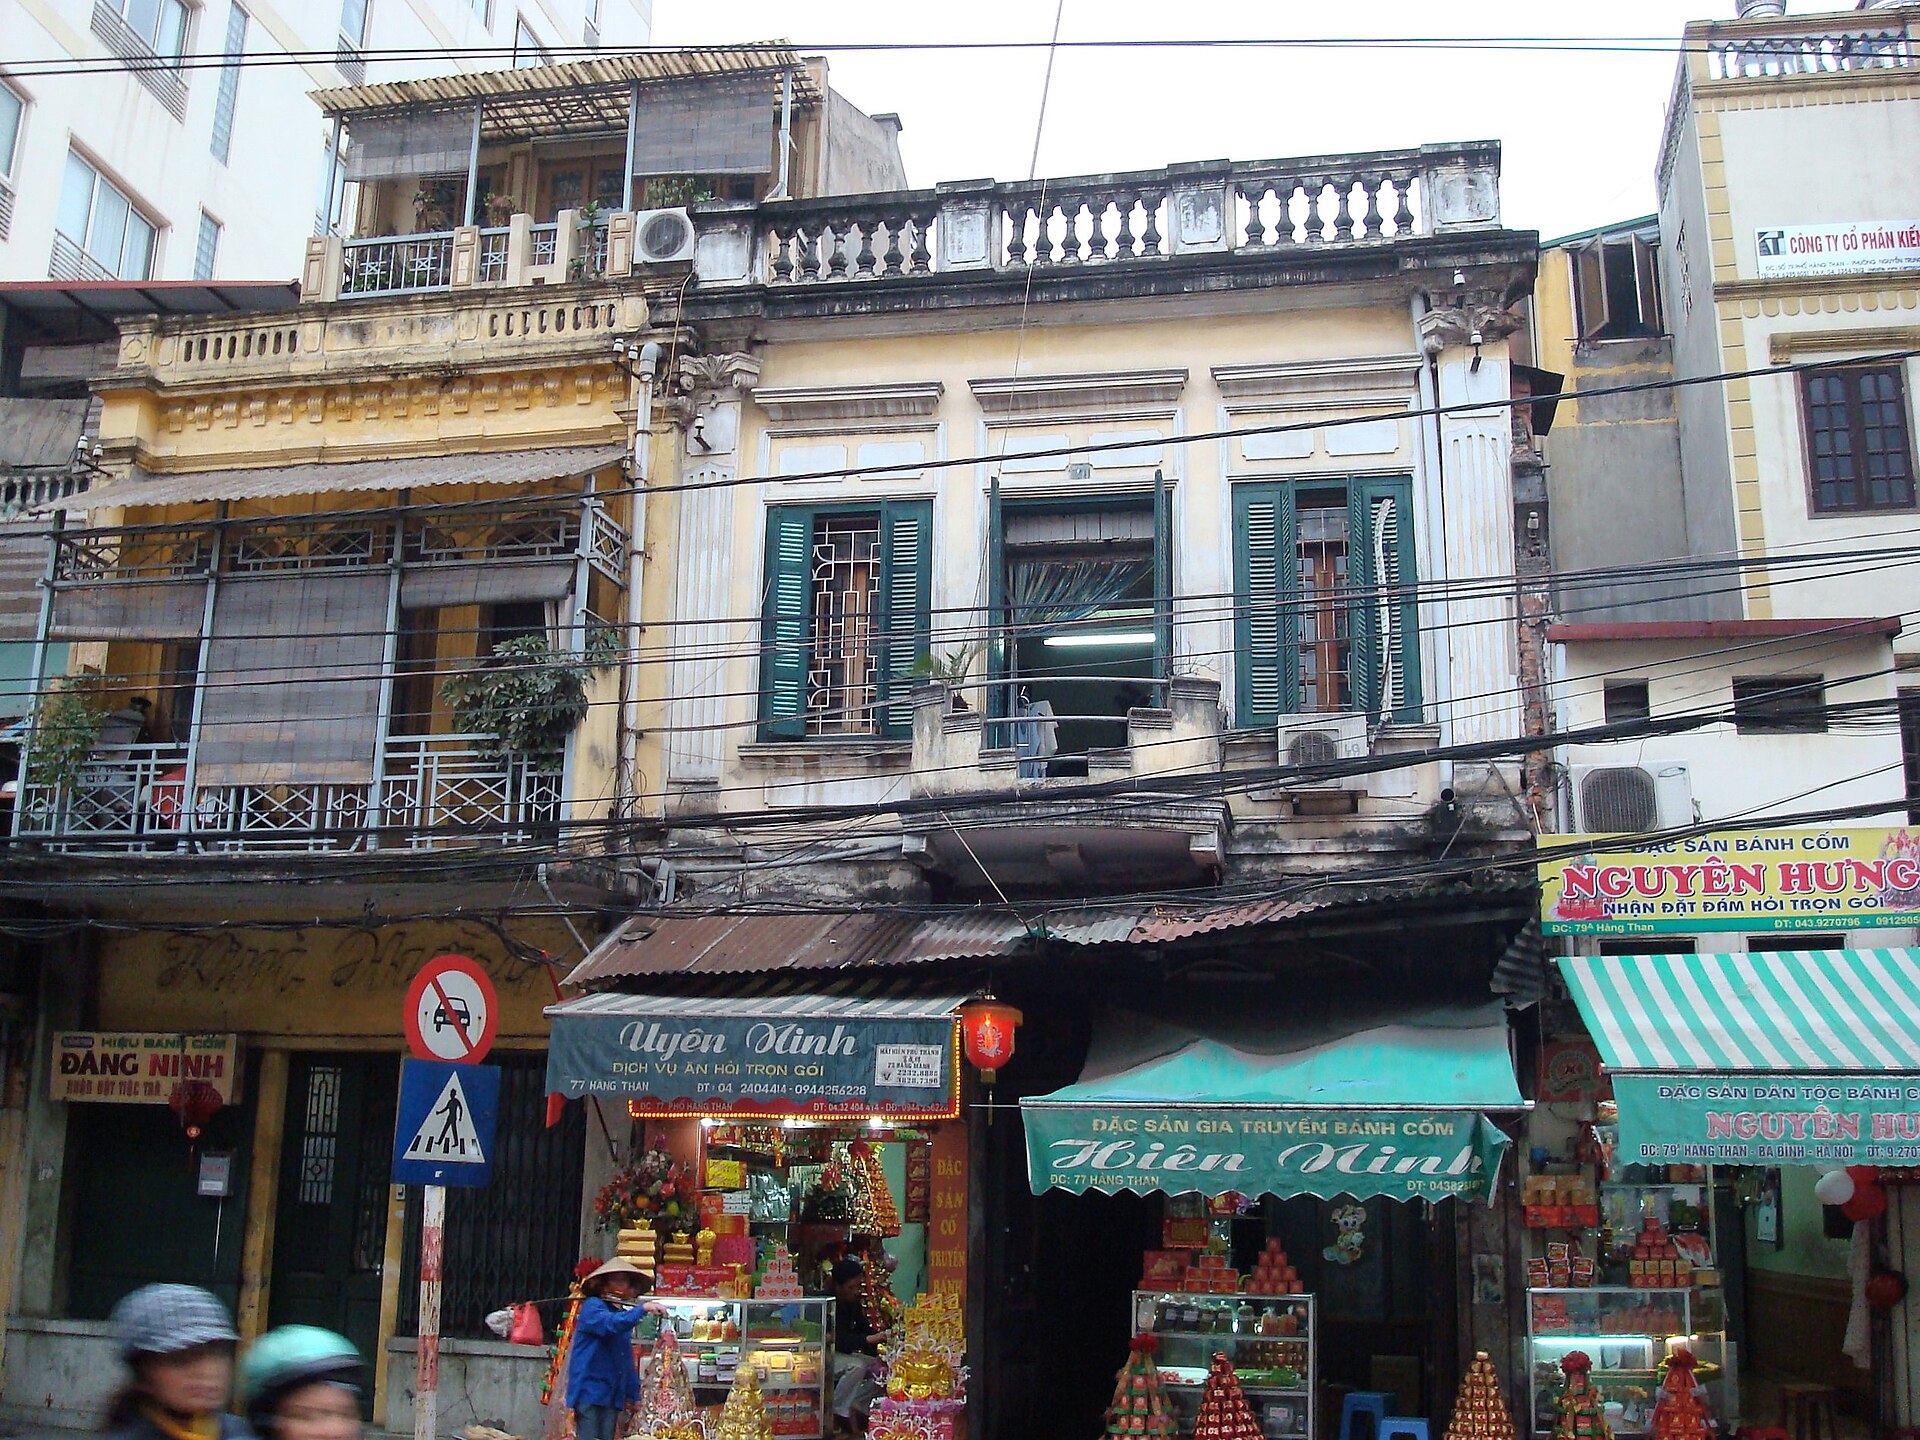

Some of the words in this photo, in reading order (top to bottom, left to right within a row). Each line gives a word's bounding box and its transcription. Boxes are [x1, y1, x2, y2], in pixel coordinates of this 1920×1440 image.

[1790, 232, 1822, 254] CÔNG
[1825, 234, 1839, 252] TY
[1345, 743, 1359, 752] LG
[1684, 835, 1728, 853] SẢN
[1735, 835, 1794, 852] BÁNH
[1801, 831, 1850, 850] CỐM
[1561, 855, 1766, 899] NGUYÊN
[1776, 858, 1920, 894] HƯNG
[1603, 899, 1655, 917] NHẬN
[1661, 899, 1697, 917] ĐẶT
[1702, 897, 1745, 913] ĐÁM
[1751, 895, 1784, 912] HỎI
[1789, 897, 1841, 913] TRỌN
[1847, 894, 1884, 908] GÓI
[1552, 925, 1572, 933] ĐC:
[1596, 923, 1625, 933] Hàng
[1627, 922, 1655, 932] Than
[1774, 919, 1792, 929] ĐT:
[1794, 917, 1861, 928] 043.9270796
[1876, 916, 1920, 926] 0912905
[619, 1021, 727, 1062] Uyên
[745, 1022, 858, 1056] Ninh
[149, 1053, 224, 1078] NINH
[613, 1062, 648, 1076] DỊCH
[655, 1063, 677, 1076] VỤ
[714, 1060, 740, 1075] HỎI
[745, 1064, 788, 1077] TRỌN
[793, 1062, 824, 1077] GÓI
[570, 1080, 586, 1090] 77
[621, 1081, 649, 1092] THAN
[1658, 1082, 1701, 1103] ĐẶC
[1753, 1083, 1796, 1100] DÂN
[1801, 1083, 1841, 1103] TỘC
[711, 1102, 733, 1111] THAN
[1092, 1116, 1138, 1135] ĐẶC
[1144, 1115, 1189, 1133] SẢN
[1196, 1120, 1234, 1134] GIA
[1240, 1116, 1327, 1135] TRUYỀN
[1335, 1118, 1396, 1136] BÁNH
[1403, 1117, 1454, 1136] CỐM
[1706, 1105, 1860, 1140] NGUYÊN
[1049, 1139, 1253, 1171] Hiên
[1641, 1144, 1660, 1157] ĐC:
[1718, 1144, 1747, 1157] THAN
[1758, 1145, 1773, 1158] BA
[1050, 1174, 1070, 1184] ĐC:
[1074, 1174, 1087, 1184] 77
[1127, 1175, 1159, 1186] THAN
[1407, 1180, 1426, 1191] ĐT:
